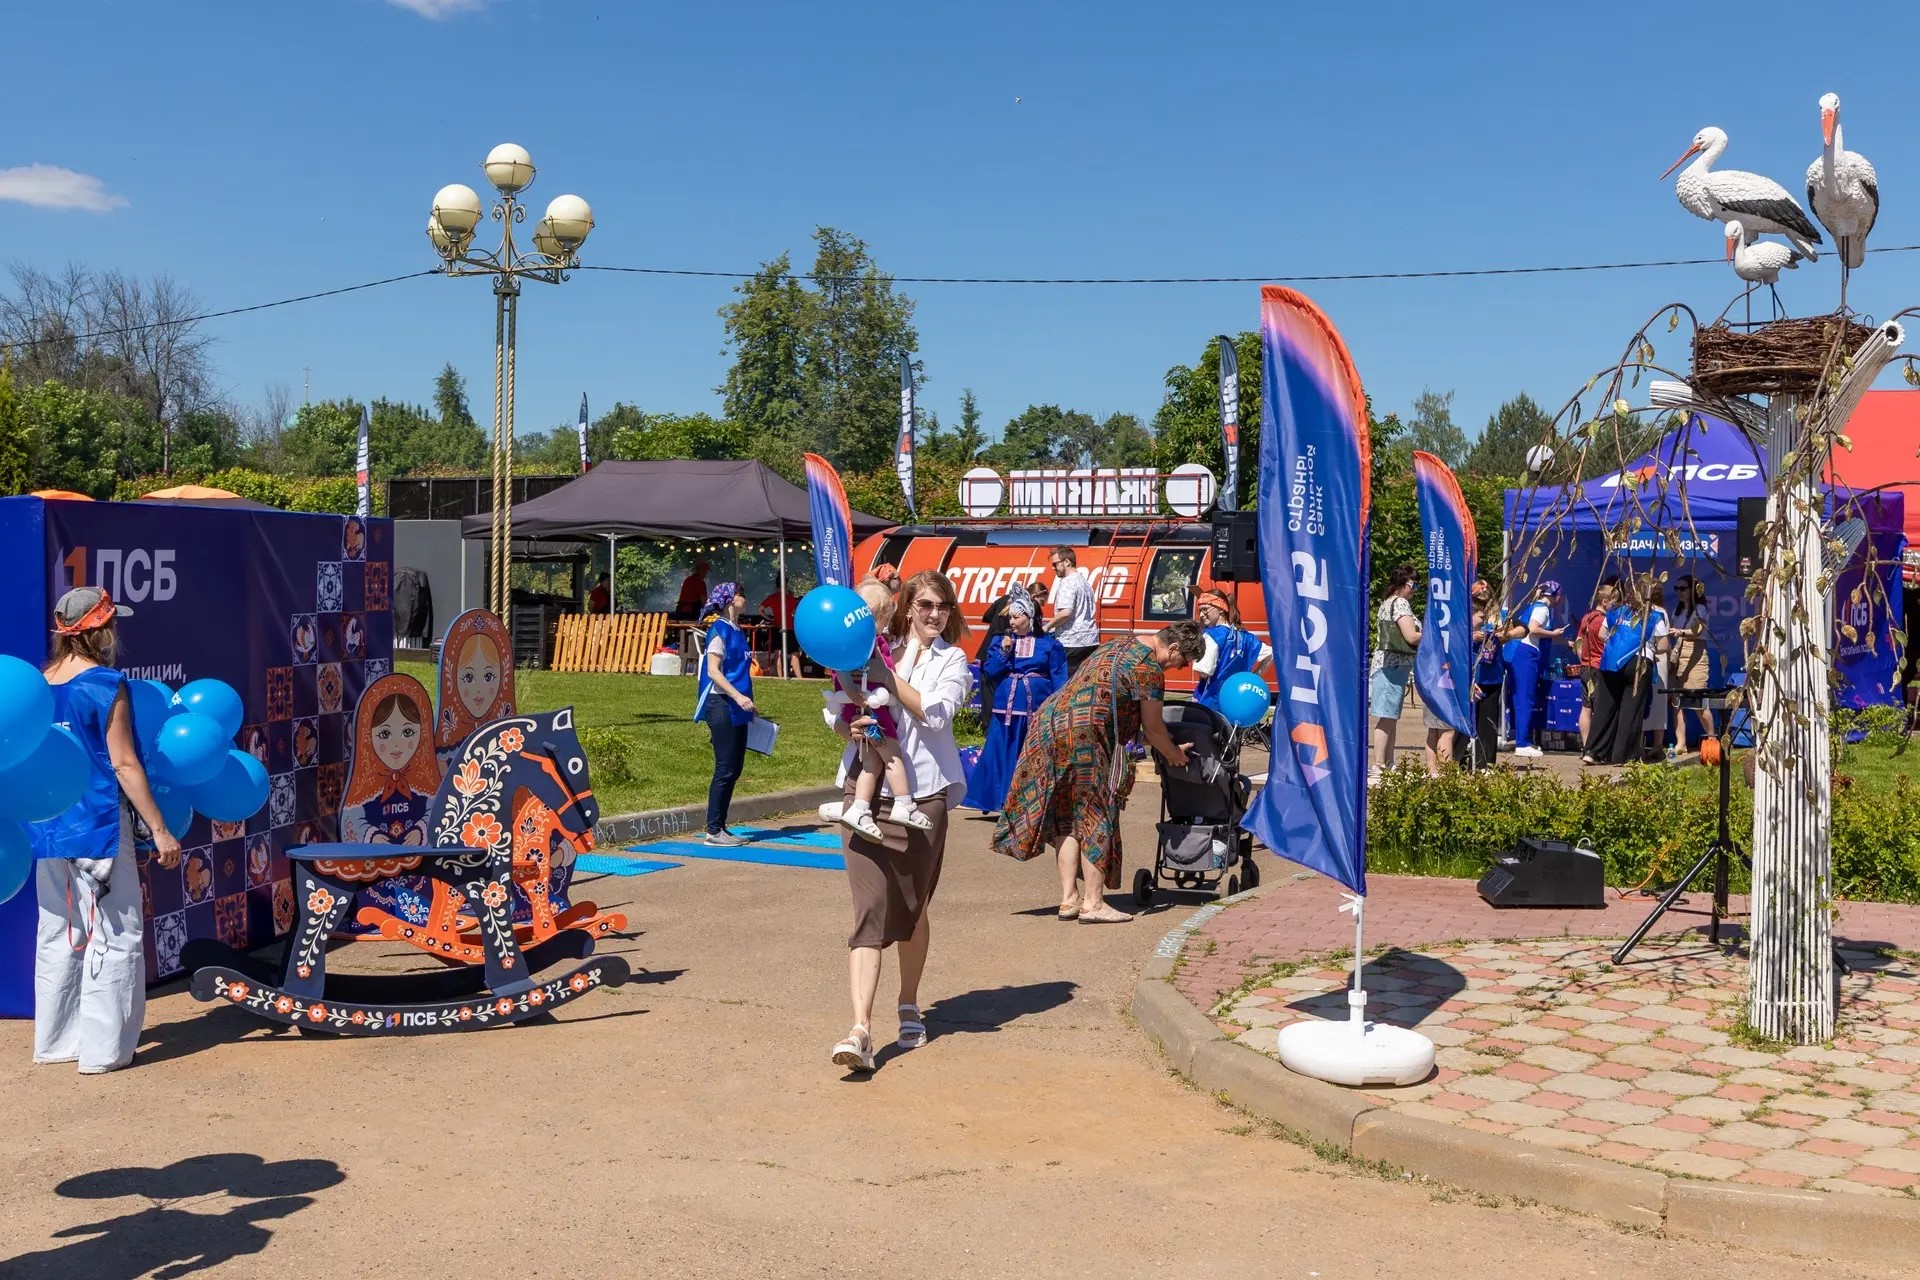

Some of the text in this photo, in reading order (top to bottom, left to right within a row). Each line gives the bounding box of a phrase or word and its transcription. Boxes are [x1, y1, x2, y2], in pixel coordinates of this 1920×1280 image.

[1668, 463, 1759, 481] ПСБ
[1663, 539, 1709, 552] ИЗОВ
[96, 548, 177, 603] ПСБ
[944, 567, 1046, 603] STREET
[1850, 602, 1867, 627] ПСБ
[391, 802, 409, 814] ПСБ
[627, 811, 690, 839] ЗАСТАВА
[403, 1011, 438, 1027] ПСБ
